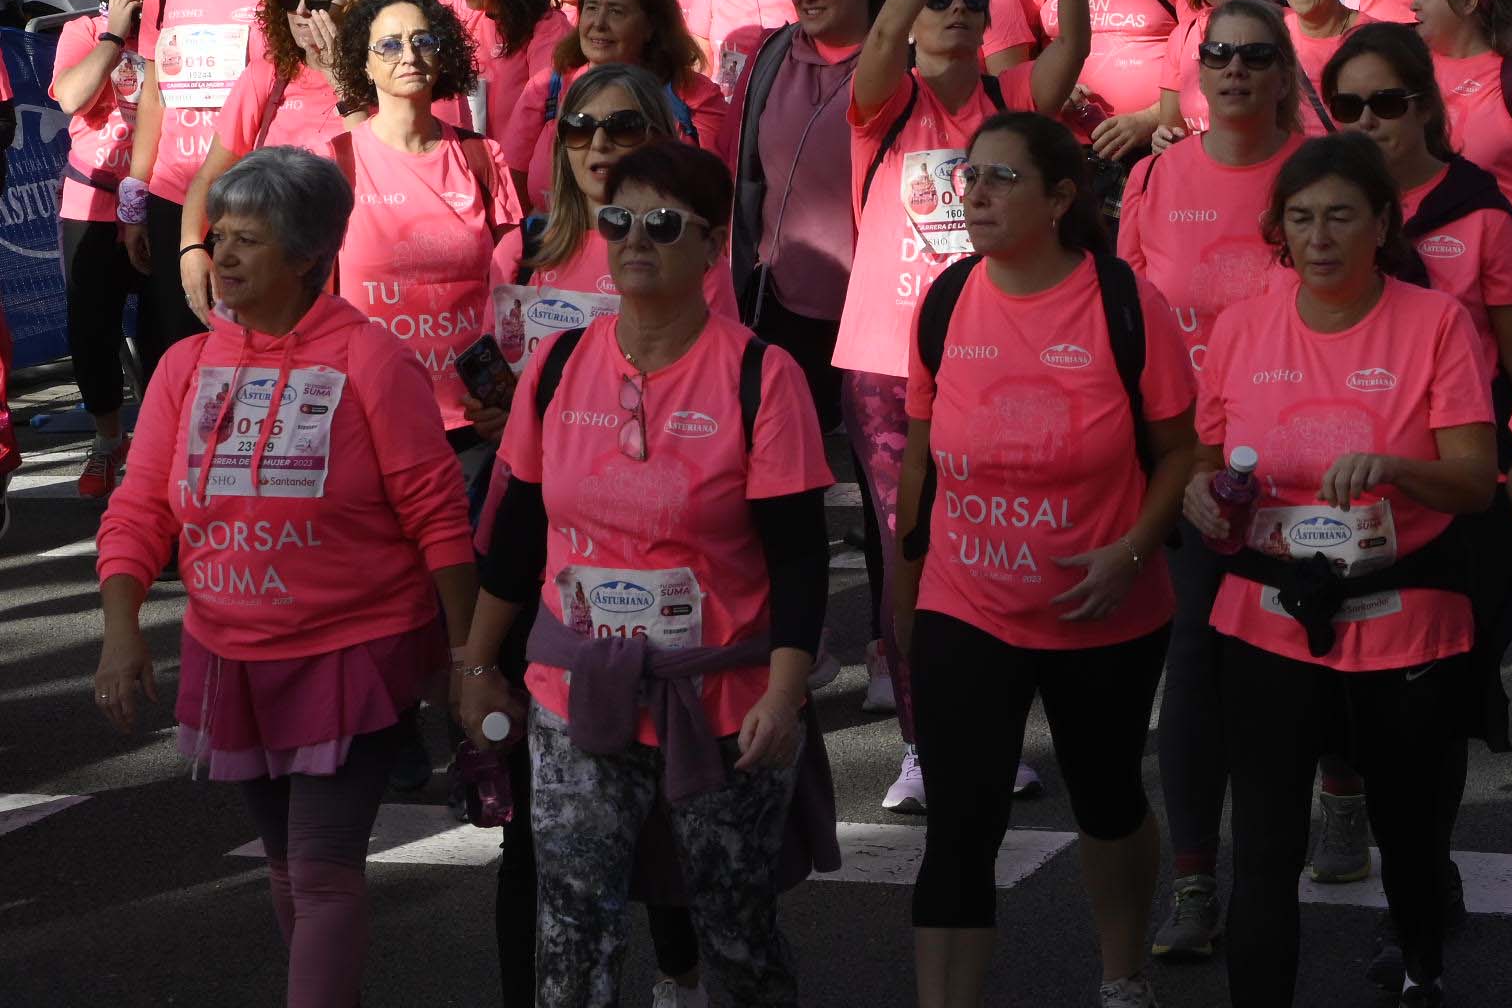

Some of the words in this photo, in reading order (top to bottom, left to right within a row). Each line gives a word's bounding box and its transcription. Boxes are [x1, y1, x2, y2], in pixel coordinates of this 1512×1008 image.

[1168, 209, 1217, 222] OYSHO
[362, 281, 400, 305] TU
[531, 307, 580, 324] ASTURIANA
[947, 345, 999, 359] OYSHO
[1043, 353, 1088, 364] ASTURIANA
[1253, 369, 1303, 385] OYSHO
[1349, 376, 1395, 387] ASTURIANA
[303, 388, 331, 396] SUMA
[562, 410, 618, 428] OYSHO
[666, 420, 714, 432] ASTURIANA
[936, 451, 968, 481] TU
[270, 477, 316, 486] Santander
[946, 491, 1074, 529] DORSAL
[183, 520, 320, 552] DORSAL
[1295, 529, 1347, 540] ASTURIANA
[948, 532, 1038, 571] UMA
[193, 560, 288, 594] SUMA
[595, 592, 650, 605] ASTURIANA
[660, 588, 690, 596] SUMA
[598, 624, 648, 640] 016
